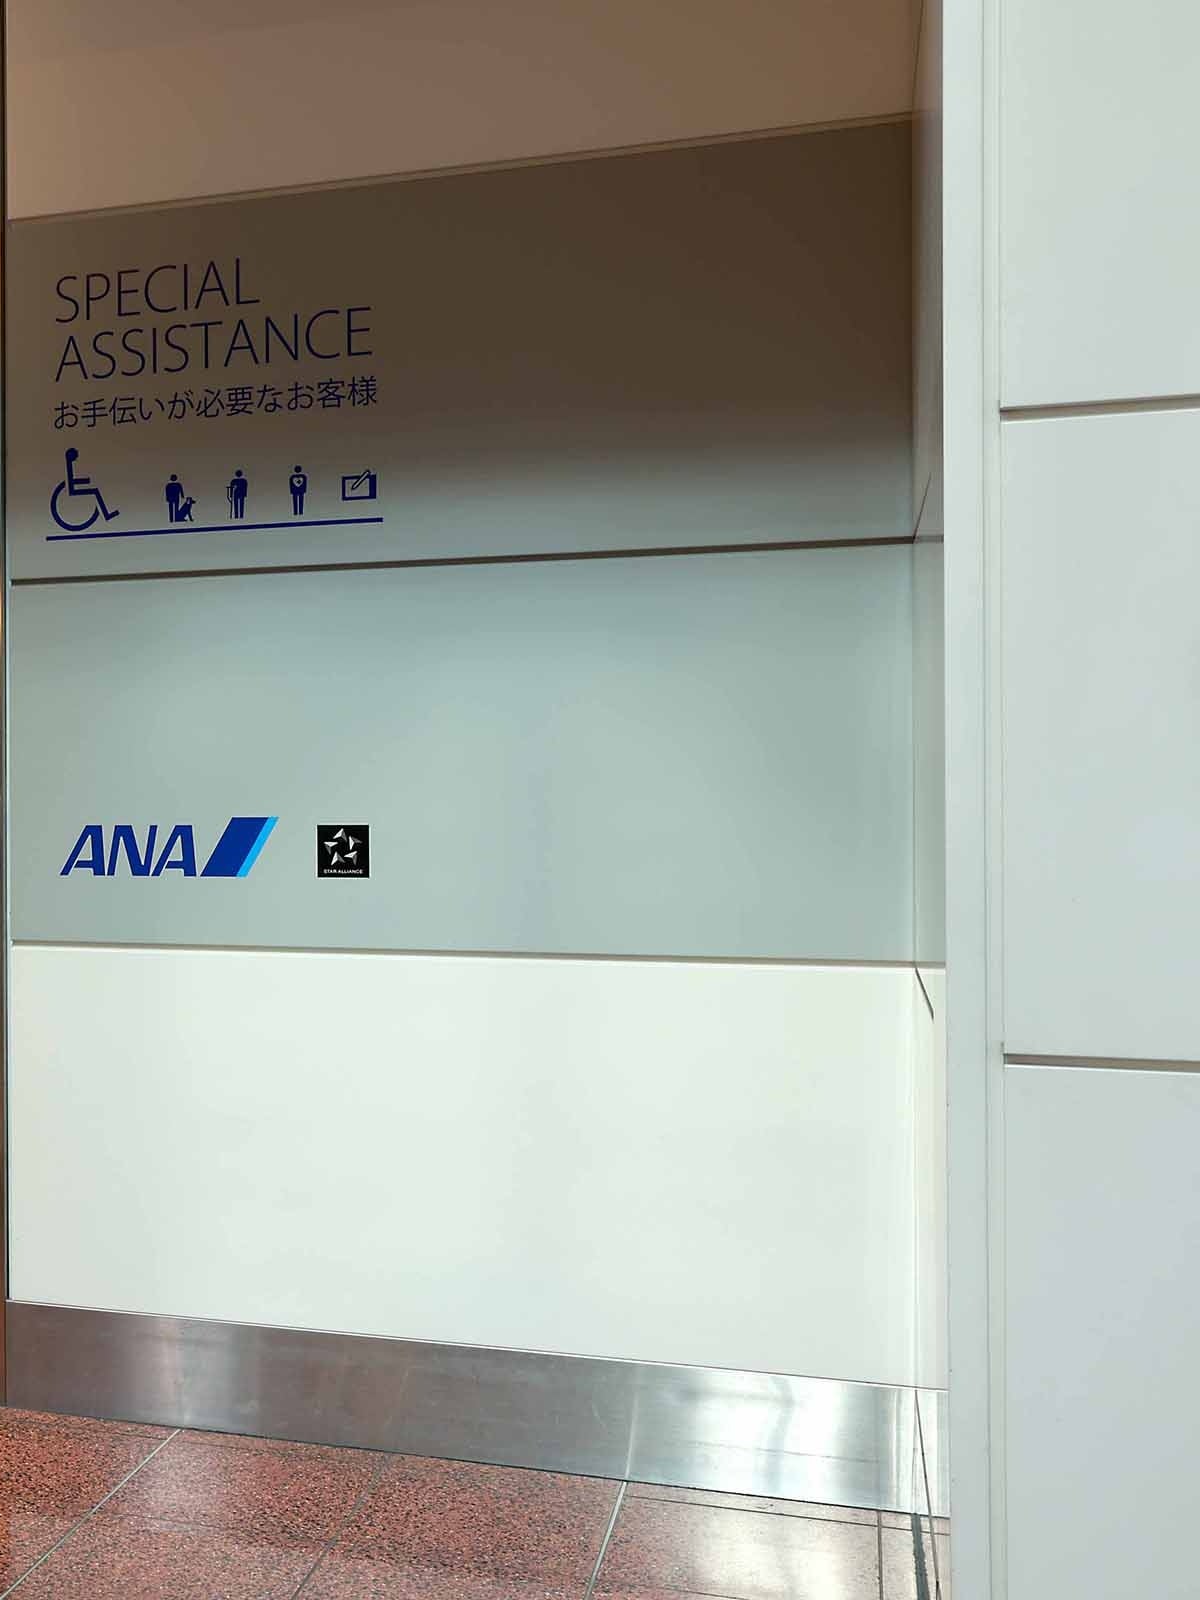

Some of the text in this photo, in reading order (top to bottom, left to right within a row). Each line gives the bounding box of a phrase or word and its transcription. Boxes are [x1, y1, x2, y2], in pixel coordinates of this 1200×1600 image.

[55, 258, 261, 323] SPECIAL
[55, 306, 373, 382] ASSISTANCE
[53, 375, 378, 429] お手伝いが必要なお客様
[59, 824, 197, 877] ANA
